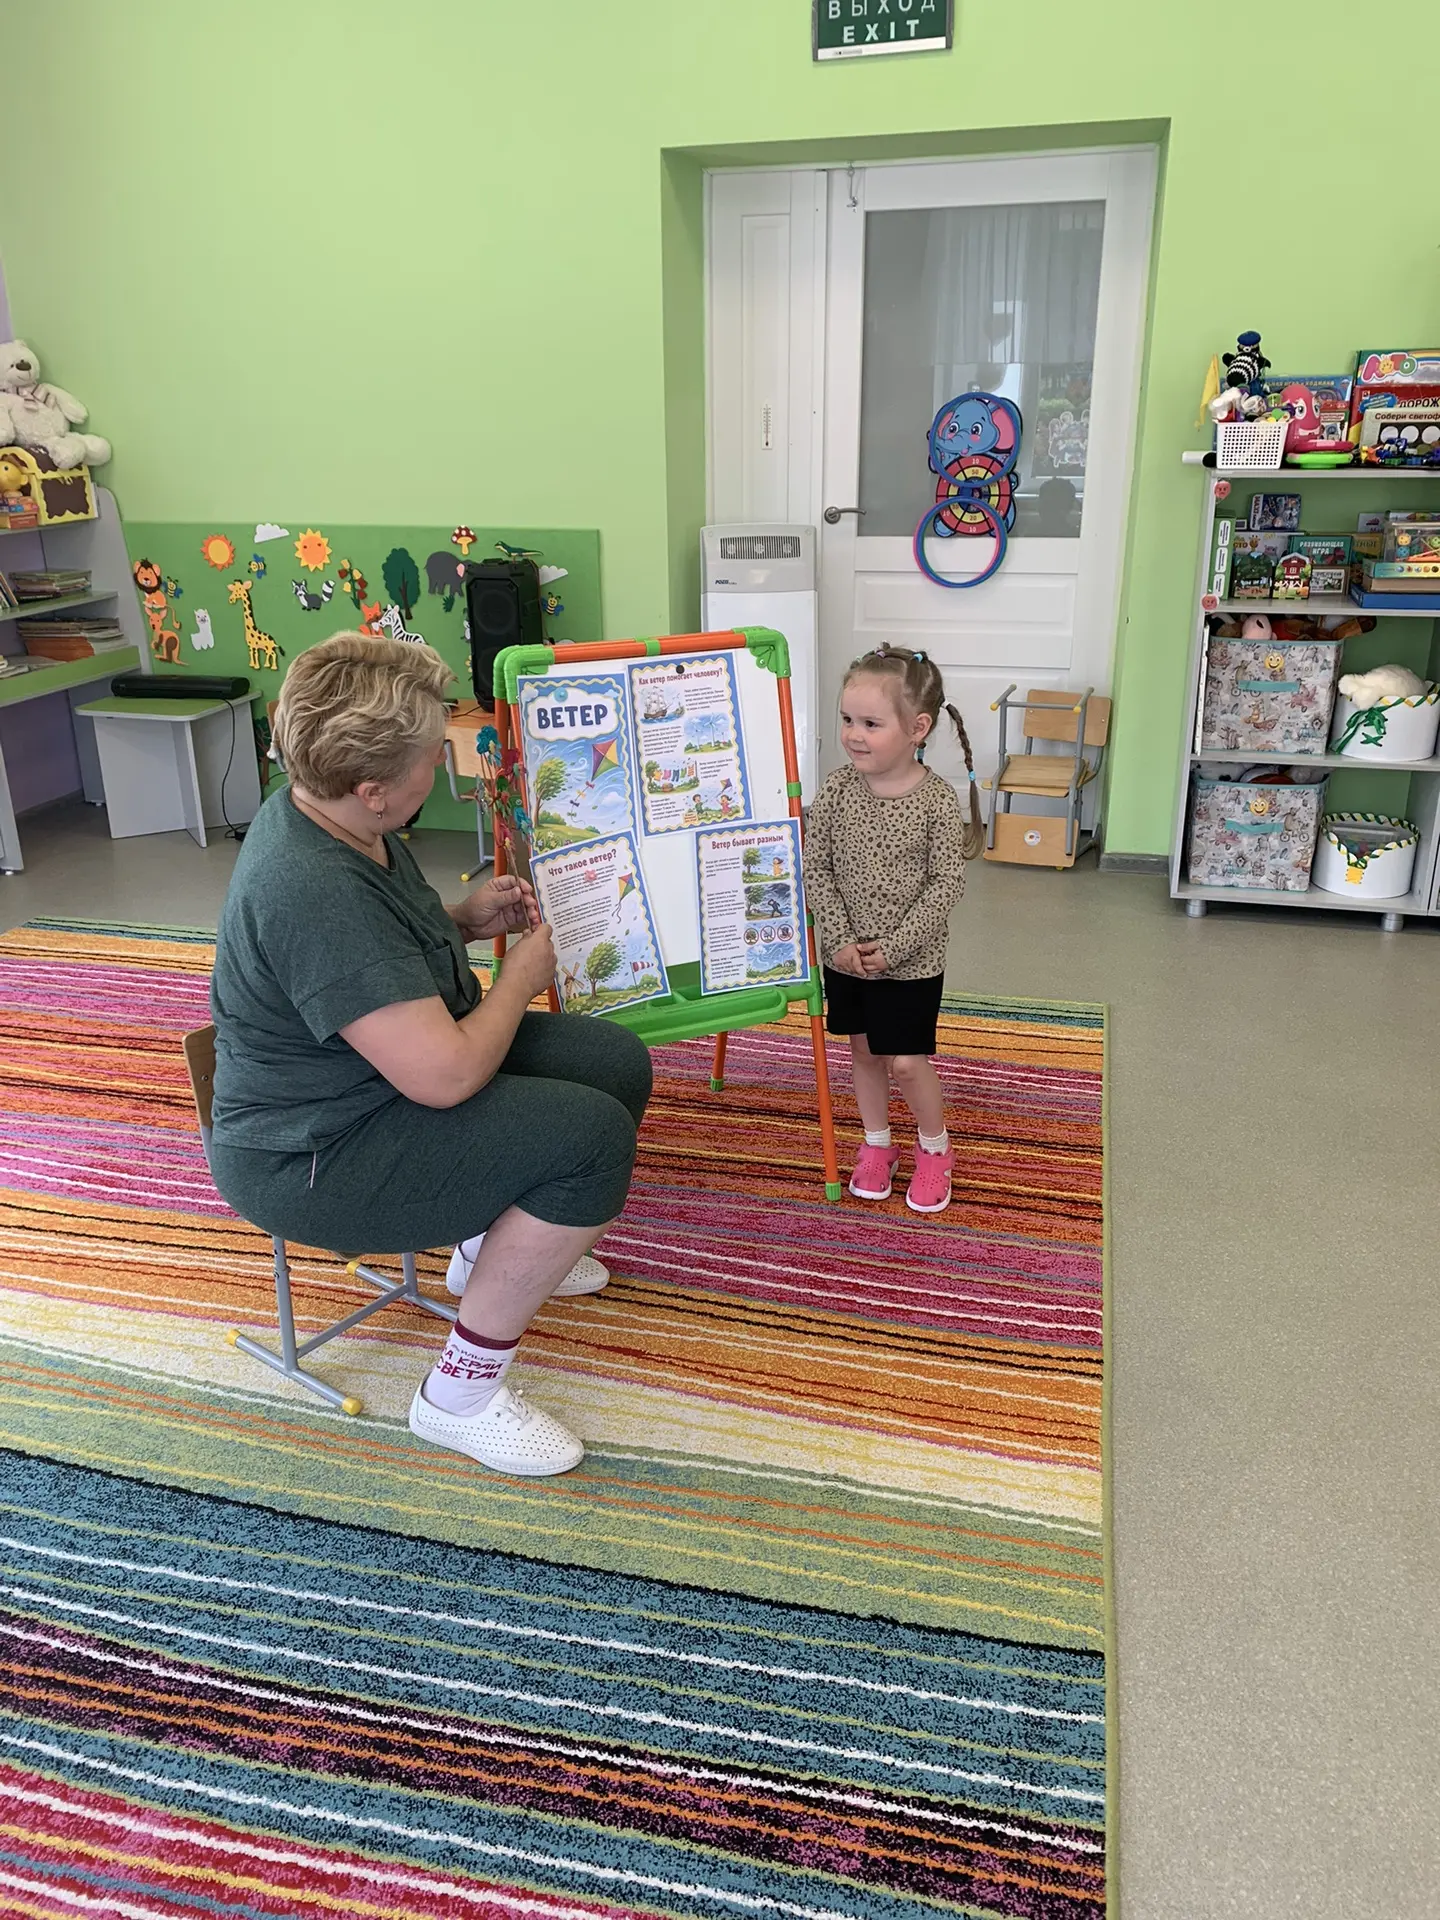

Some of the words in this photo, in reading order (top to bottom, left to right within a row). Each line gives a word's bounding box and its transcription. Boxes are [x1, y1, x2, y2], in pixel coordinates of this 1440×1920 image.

[828, 0, 935, 19] ВЫХОД
[843, 19, 919, 43] EXIT
[1375, 412, 1407, 421] Собери
[1312, 547, 1330, 555] ИГРА
[638, 677, 649, 685] Как
[650, 676, 666, 684] ветер
[666, 672, 693, 682] помогает
[693, 667, 723, 678] человеку?
[537, 704, 608, 729] ВЕТЕР
[711, 840, 731, 850] Ветер
[732, 837, 756, 847] бывает
[757, 835, 784, 845] разным
[548, 867, 563, 877] Что
[564, 860, 587, 872] такое
[589, 848, 617, 865] ветер?
